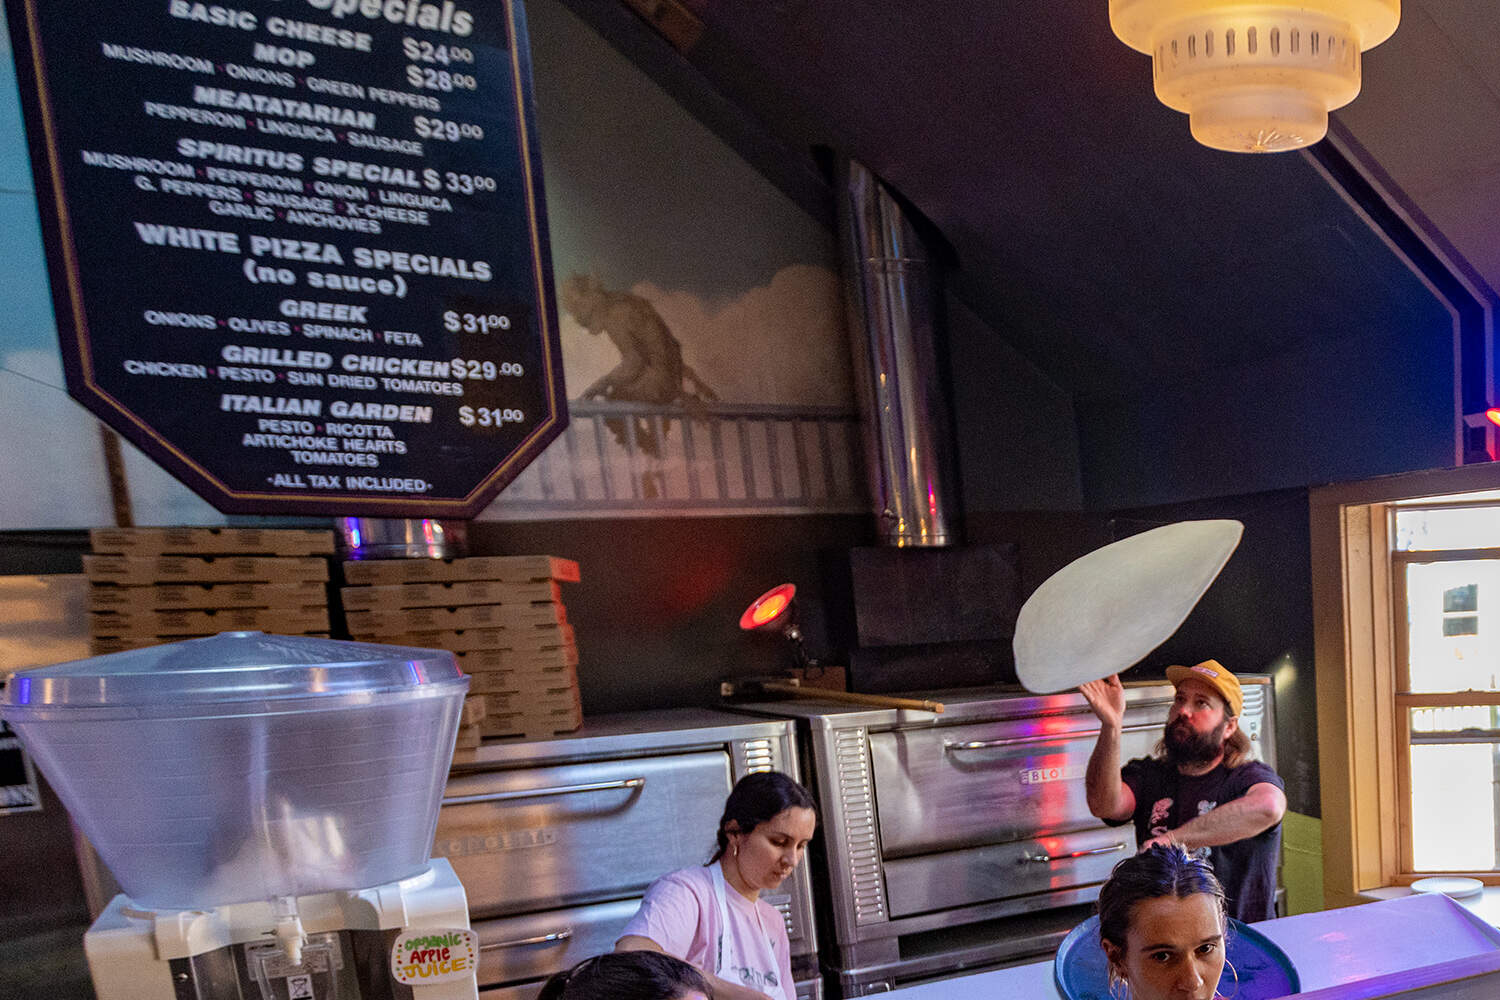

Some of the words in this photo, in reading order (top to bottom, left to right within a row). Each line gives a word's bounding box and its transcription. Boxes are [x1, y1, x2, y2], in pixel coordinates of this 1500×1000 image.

[169, 0, 258, 31] BASIC
[266, 16, 373, 52] CHEESE
[304, 0, 474, 37] pecials
[253, 42, 316, 68] MOP
[102, 42, 215, 75] MUSHROOM
[225, 63, 296, 89] ONIONS
[306, 76, 365, 99] GREEN
[368, 86, 441, 112] PEPPERS
[193, 85, 376, 130] MEATATARIAN
[144, 101, 246, 129] PEPPERONI
[257, 118, 337, 143] LINGUICA
[347, 131, 424, 157] SAUSAGE
[81, 150, 196, 179] MUSHROOM
[206, 166, 304, 193] PEPPERONI
[313, 181, 369, 201] ONION
[378, 190, 453, 212] LINGUICA
[177, 138, 304, 172] SPIRITUS
[312, 157, 421, 188] SPECIAL
[134, 175, 158, 192] G.
[160, 178, 243, 201] PEPPERS
[253, 189, 335, 214] SAUSAGE
[346, 202, 431, 226] X-CHEESE
[208, 200, 276, 222] GARLIC
[286, 209, 382, 235] ANCHOVIES
[133, 221, 241, 254] WHITE
[250, 234, 345, 266] PIZZA
[353, 247, 493, 282] SPECIALS
[243, 258, 296, 284] (no
[306, 271, 408, 298] sauce)
[143, 309, 217, 330] ONIONS
[227, 316, 292, 336] OLIVES
[302, 323, 374, 343] SPINACH
[383, 330, 424, 347] FETA
[279, 299, 368, 324] GREEK
[123, 359, 208, 379] CHICKEN
[216, 366, 276, 384] PESTO
[286, 370, 325, 387] SUN
[327, 374, 378, 390] DRIED
[380, 377, 464, 397] TOMATOES
[221, 344, 333, 370] GRILLED
[341, 354, 450, 379] CHICKEN
[219, 393, 323, 416] ITALIAN
[330, 400, 433, 424] GARDEN
[242, 433, 338, 451] ARTICHOKE
[343, 438, 408, 454] HEARTS
[258, 418, 315, 435] PESTO
[325, 422, 395, 439] RICOTTA
[290, 450, 379, 468] TOMATOES
[308, 475, 341, 489] TAX
